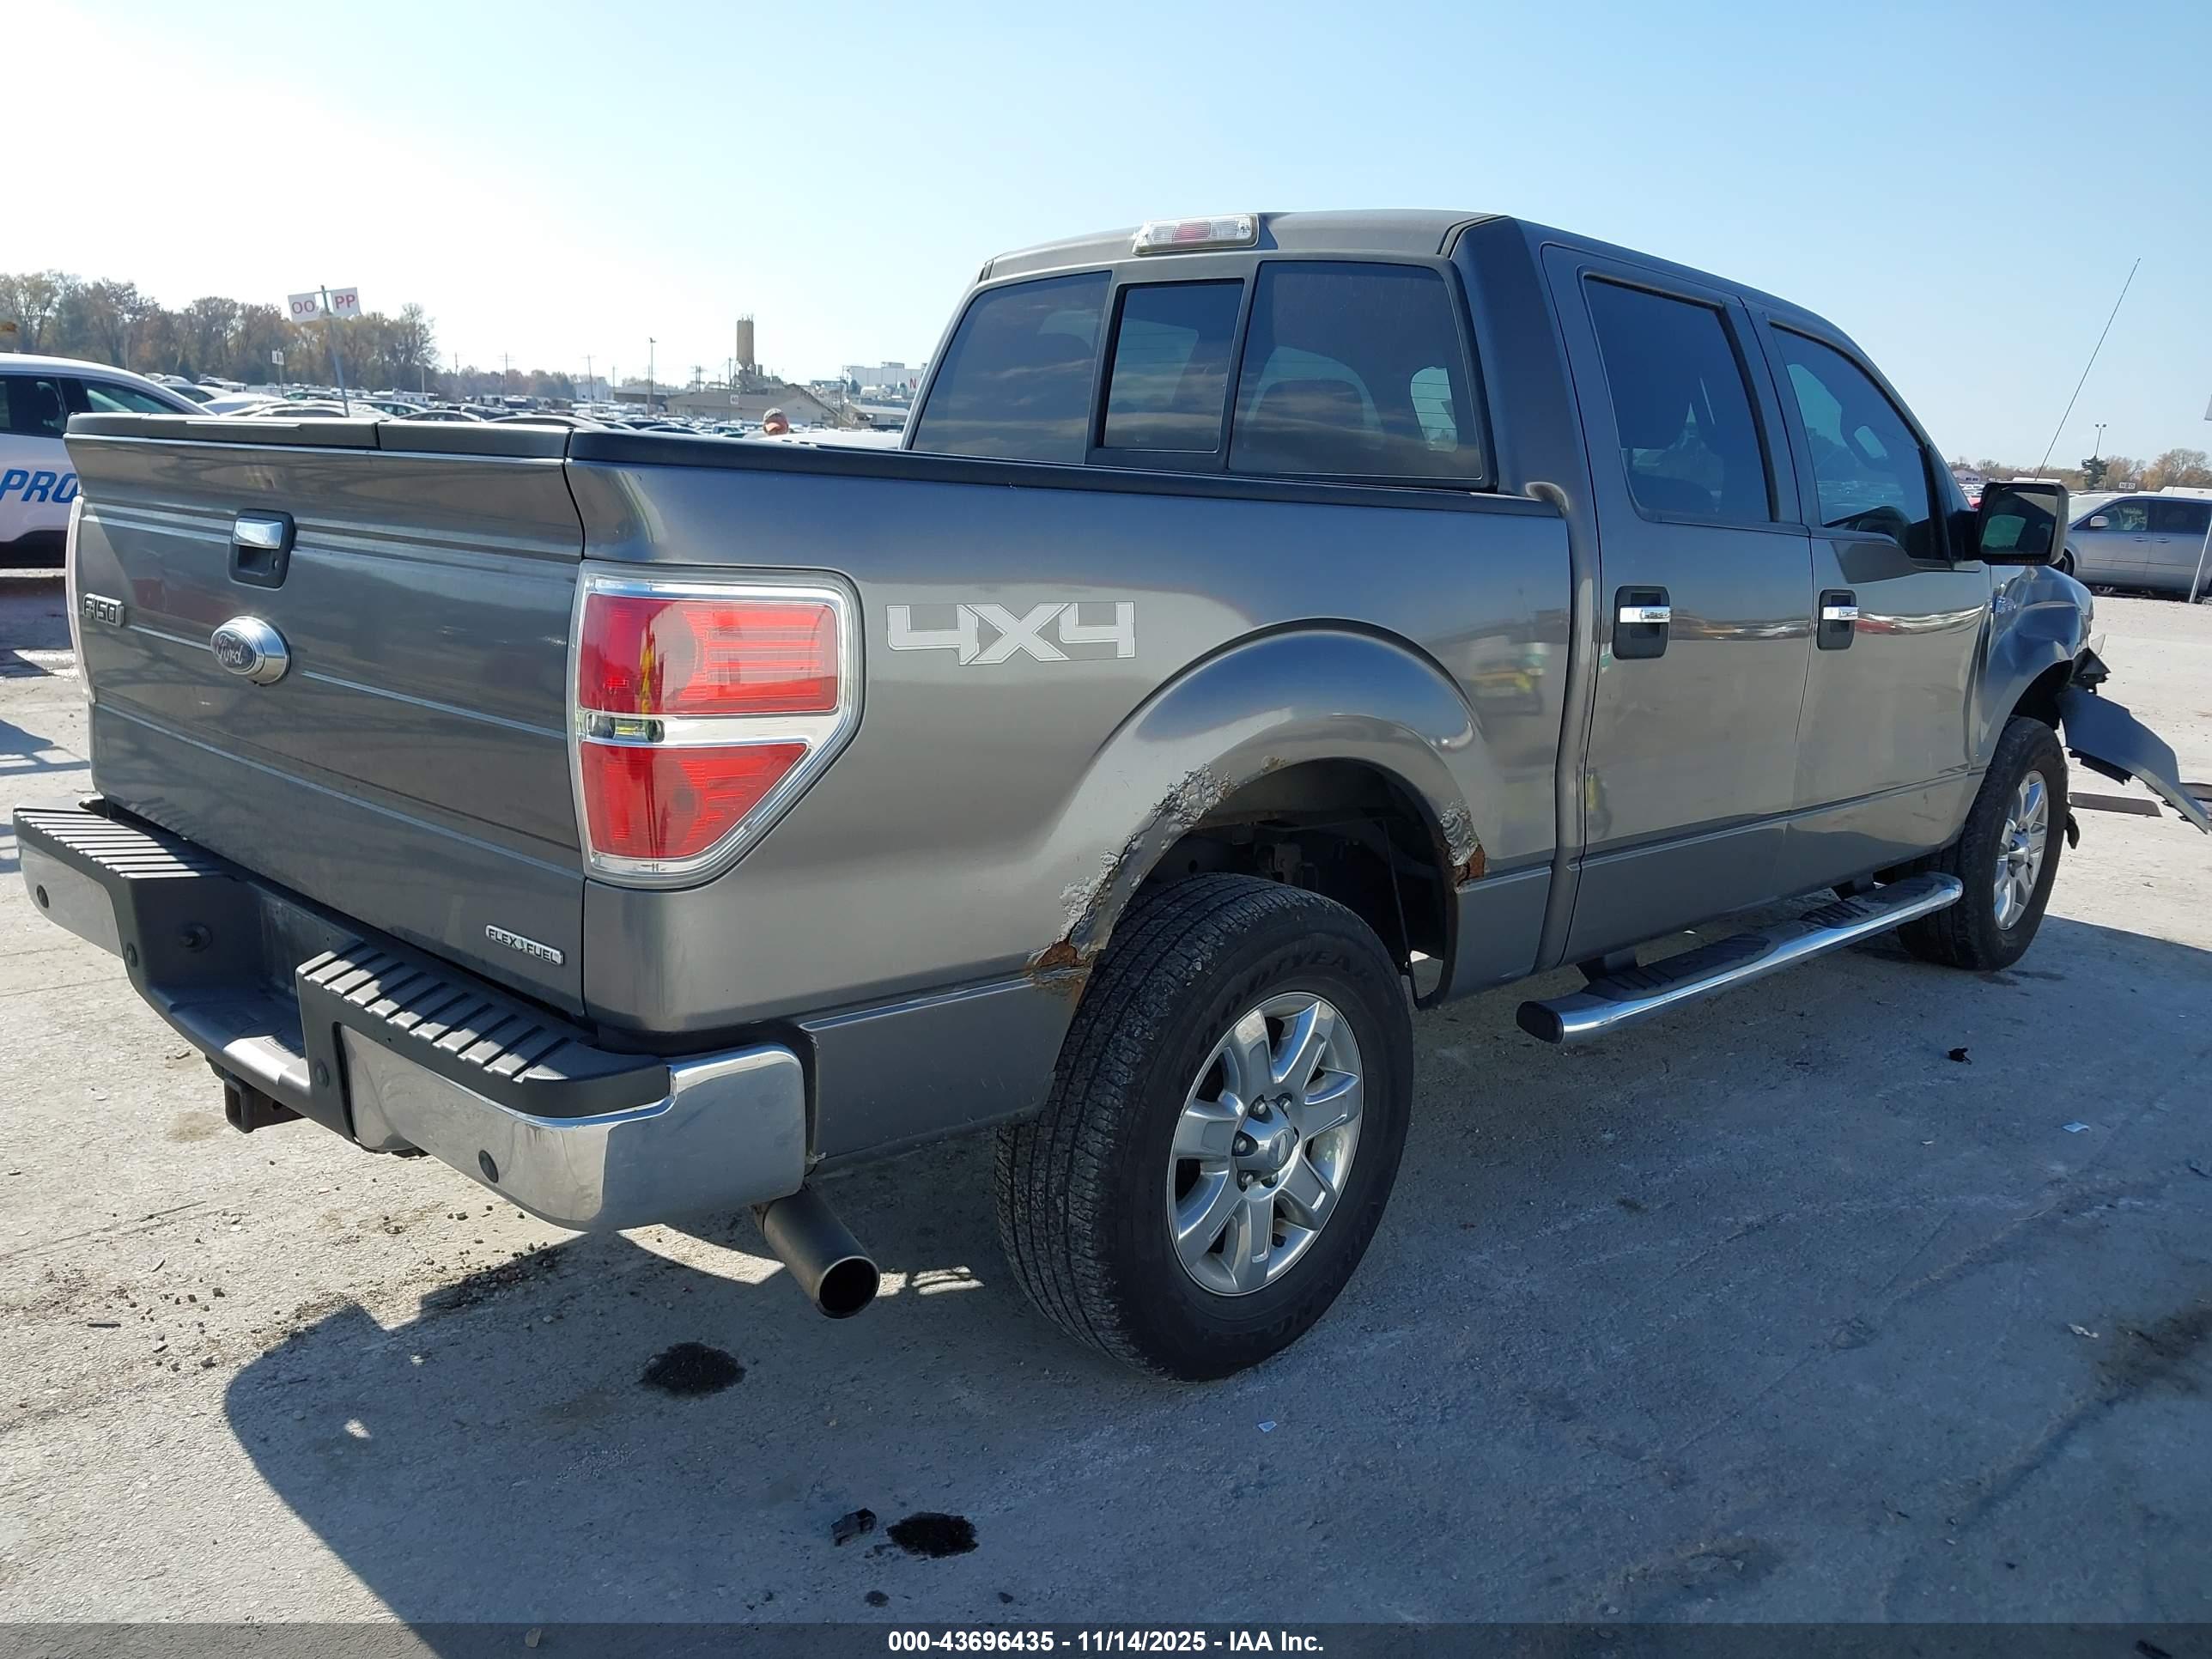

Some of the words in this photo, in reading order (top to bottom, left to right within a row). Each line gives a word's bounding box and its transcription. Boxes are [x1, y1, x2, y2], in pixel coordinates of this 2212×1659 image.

[291, 300, 315, 314] OO
[334, 294, 356, 309] PP
[216, 632, 244, 665] Ford
[886, 601, 1136, 666] 4X4
[488, 927, 517, 949] FLEX
[526, 941, 558, 964] FUEL
